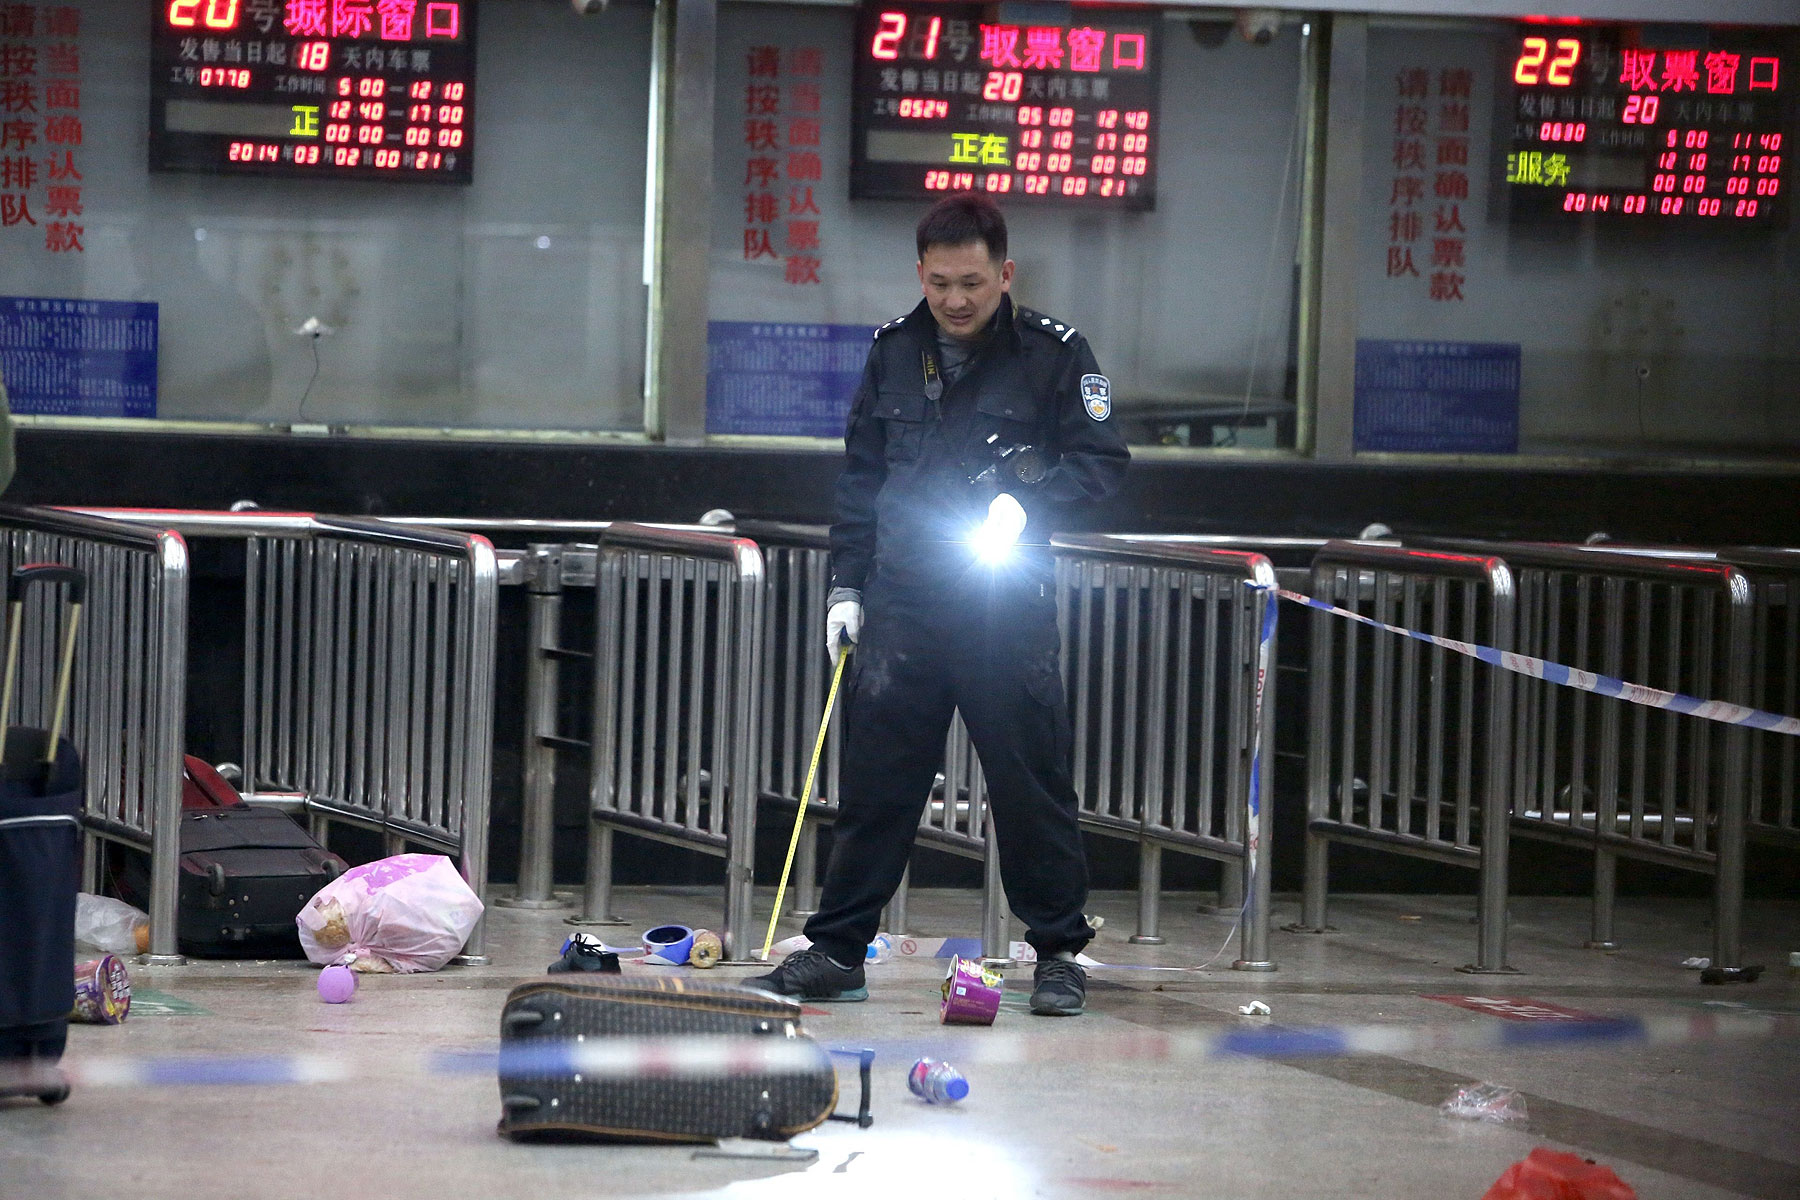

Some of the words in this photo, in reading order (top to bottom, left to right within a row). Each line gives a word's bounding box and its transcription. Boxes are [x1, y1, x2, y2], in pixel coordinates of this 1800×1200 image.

[167, 0, 238, 28] 20
[283, 0, 460, 41] 城际窗口
[871, 11, 942, 61] 21
[979, 23, 1146, 73] 取票窗口
[1514, 36, 1581, 87] 22
[1620, 48, 1780, 94] 取票窗口
[43, 5, 85, 253] 请当面确认票款
[289, 104, 321, 137] 正
[949, 132, 1011, 167] 正在
[744, 45, 781, 261] 请按秩序排队
